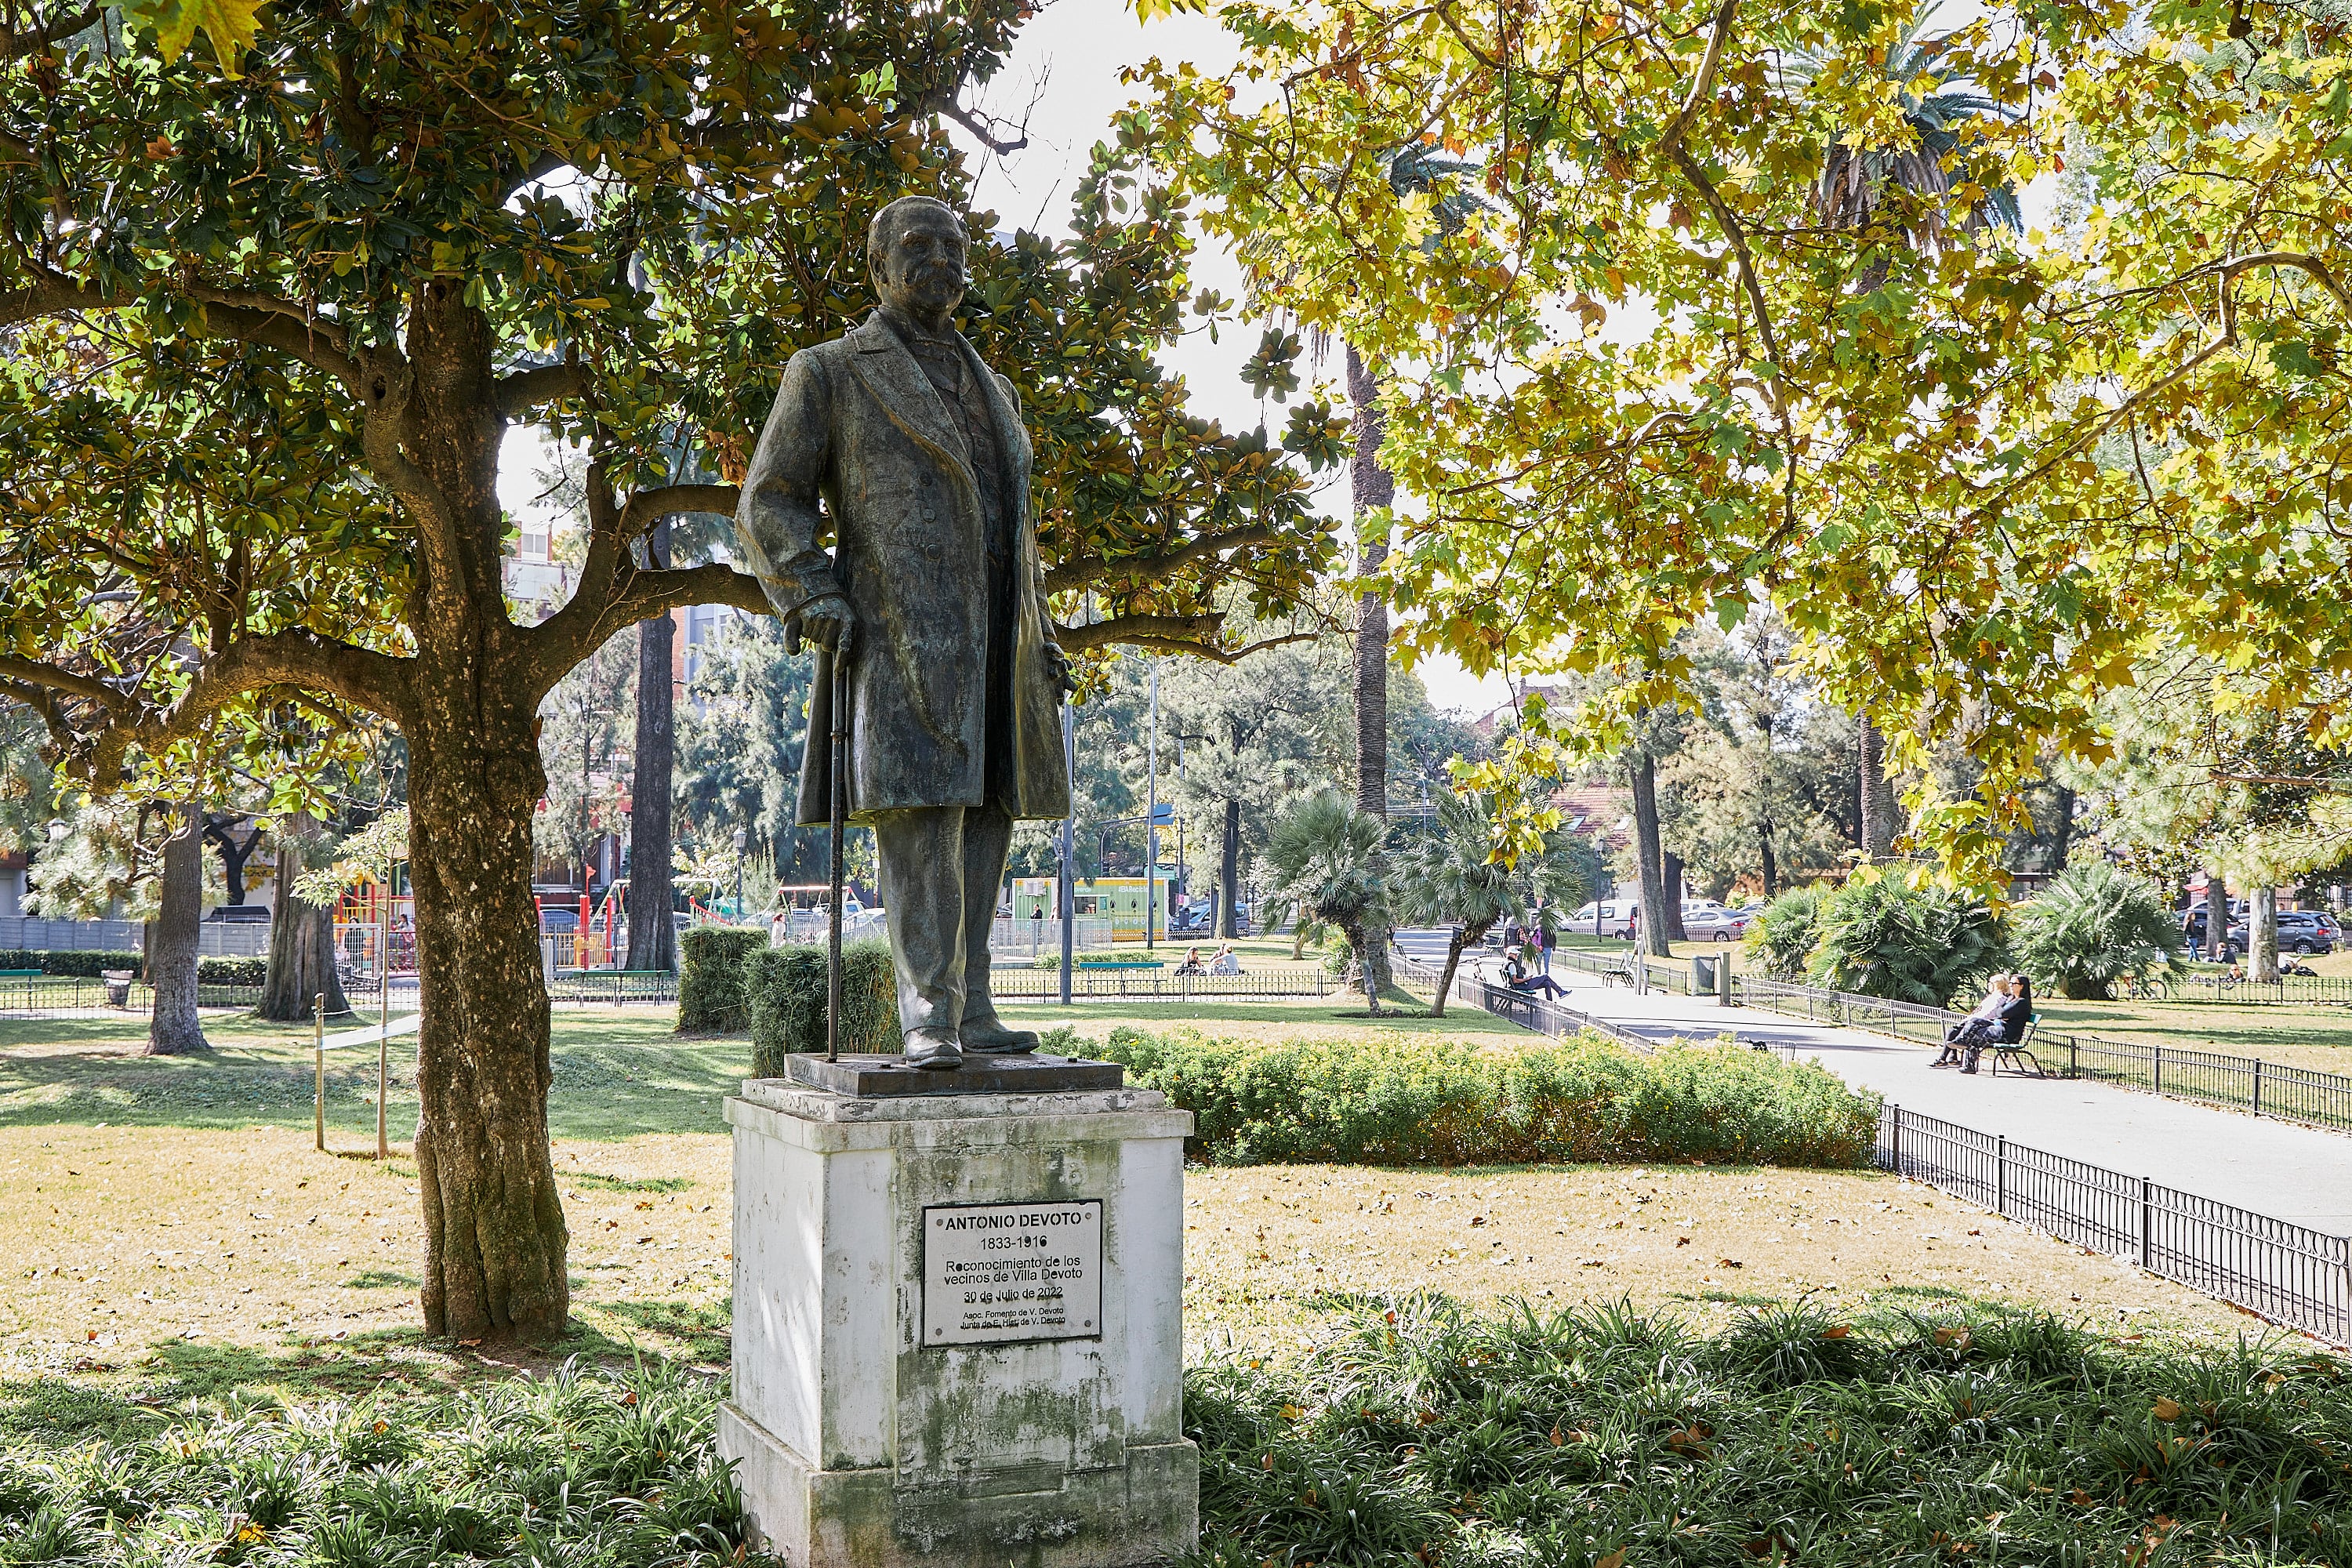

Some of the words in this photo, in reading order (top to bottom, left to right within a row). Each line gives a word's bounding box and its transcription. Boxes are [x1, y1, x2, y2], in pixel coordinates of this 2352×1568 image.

[946, 1215, 1014, 1230] ANTONIO
[1020, 1212, 1081, 1227] DEVOTO
[981, 1235, 1047, 1250] 1833-1916
[946, 1258, 1041, 1272] Reconocimiento
[1046, 1256, 1060, 1267] de
[1064, 1255, 1080, 1266] los
[944, 1273, 990, 1285] vecinos
[993, 1271, 1009, 1282] de
[1012, 1270, 1036, 1281] Villa
[1042, 1268, 1082, 1279] Devoto
[964, 1291, 976, 1302] 30
[980, 1291, 993, 1301] de
[996, 1290, 1019, 1301] Julio
[1022, 1289, 1035, 1298] de
[1037, 1287, 1063, 1298] 2022
[985, 1309, 1017, 1318] Fomento
